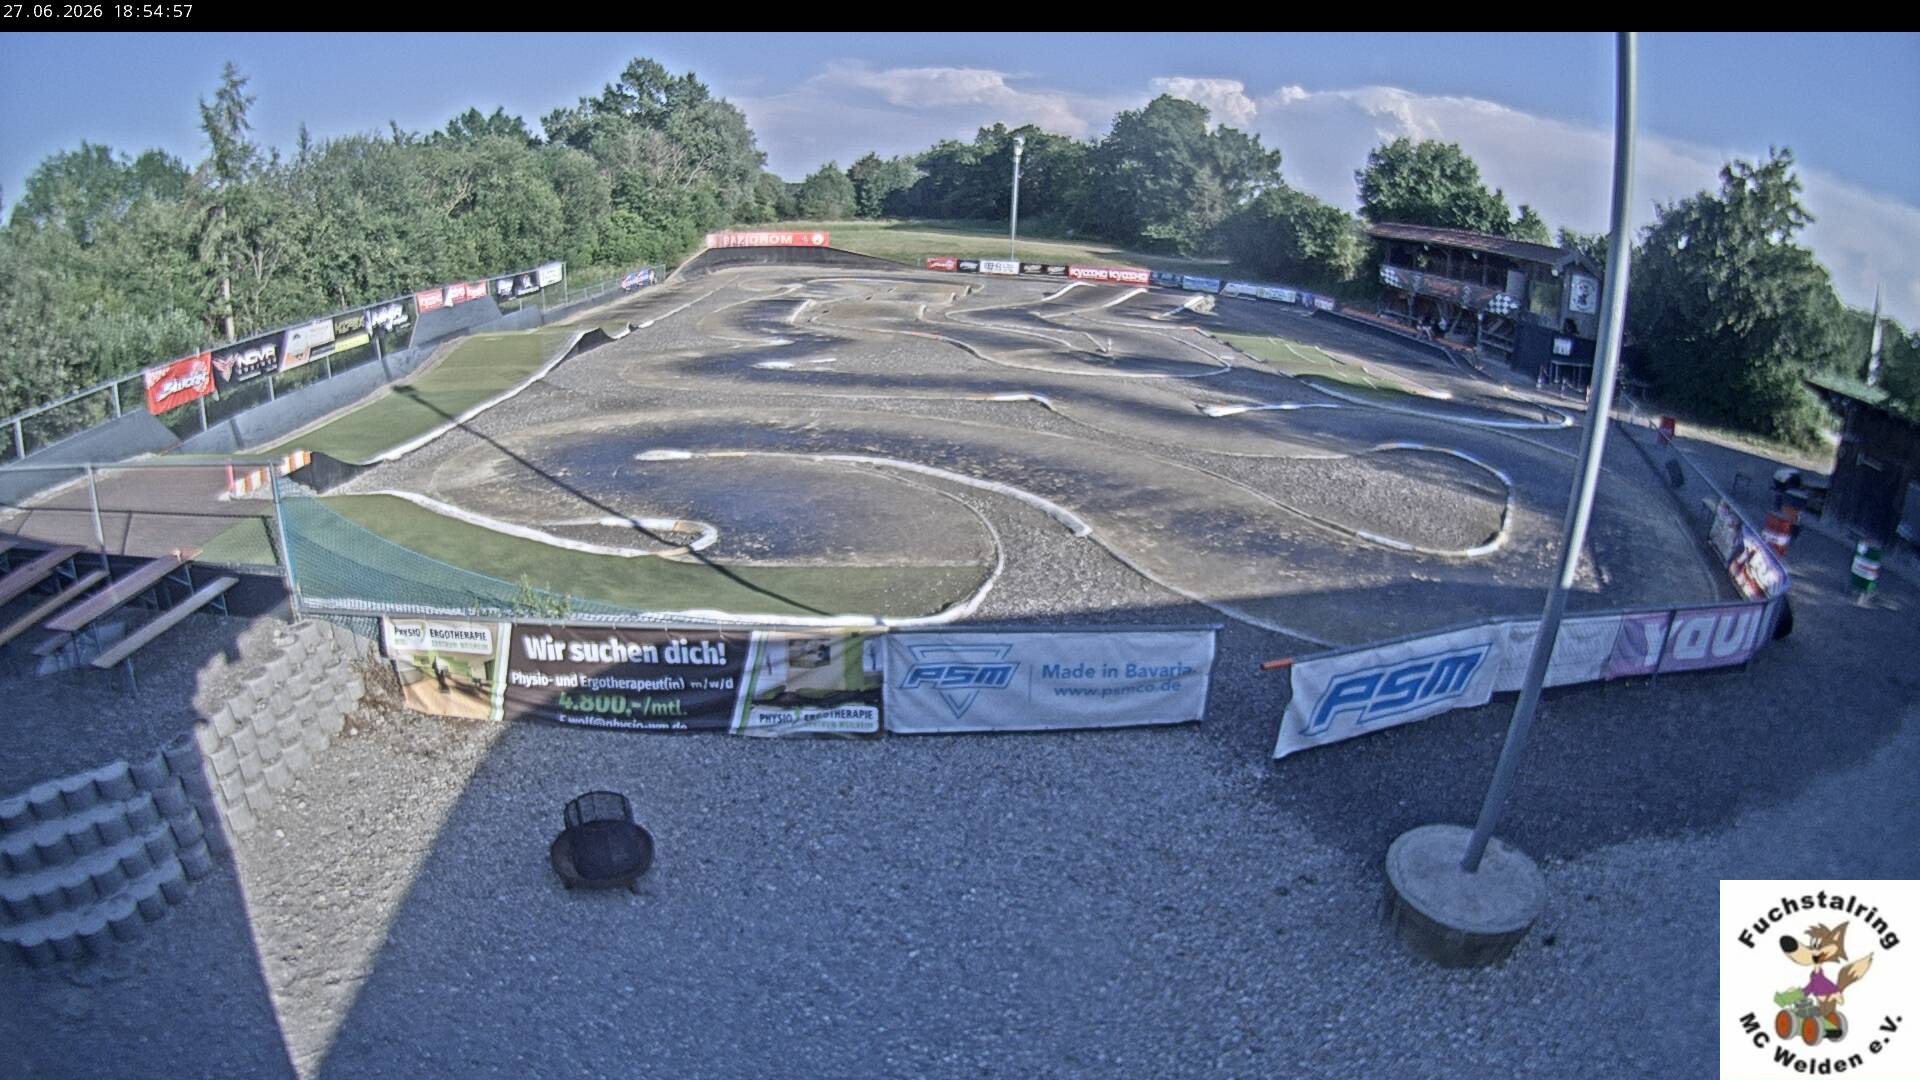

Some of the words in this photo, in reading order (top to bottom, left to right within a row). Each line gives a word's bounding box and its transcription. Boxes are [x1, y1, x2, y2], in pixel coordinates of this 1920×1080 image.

[394, 626, 421, 638] PHYSIO
[429, 628, 487, 641] ERGOTHERAPIE
[521, 634, 566, 662] Wir
[569, 634, 658, 664] suchen
[664, 638, 727, 665] dich!
[906, 665, 1012, 687] PSM
[1042, 663, 1095, 679] Made
[1102, 662, 1119, 679] in
[1124, 661, 1194, 680] Bavaria
[511, 671, 553, 688] Physio-
[555, 672, 578, 688] und
[580, 675, 685, 692] Ergotherapeut(in)
[690, 677, 735, 690] m/w/d
[1054, 680, 1182, 698] www.psmco.de
[1312, 650, 1484, 727] PSM
[559, 691, 688, 717] 4.800,-/mtl.
[759, 713, 793, 724] PHYSIO
[804, 709, 873, 722] ERGOTHERAPIE
